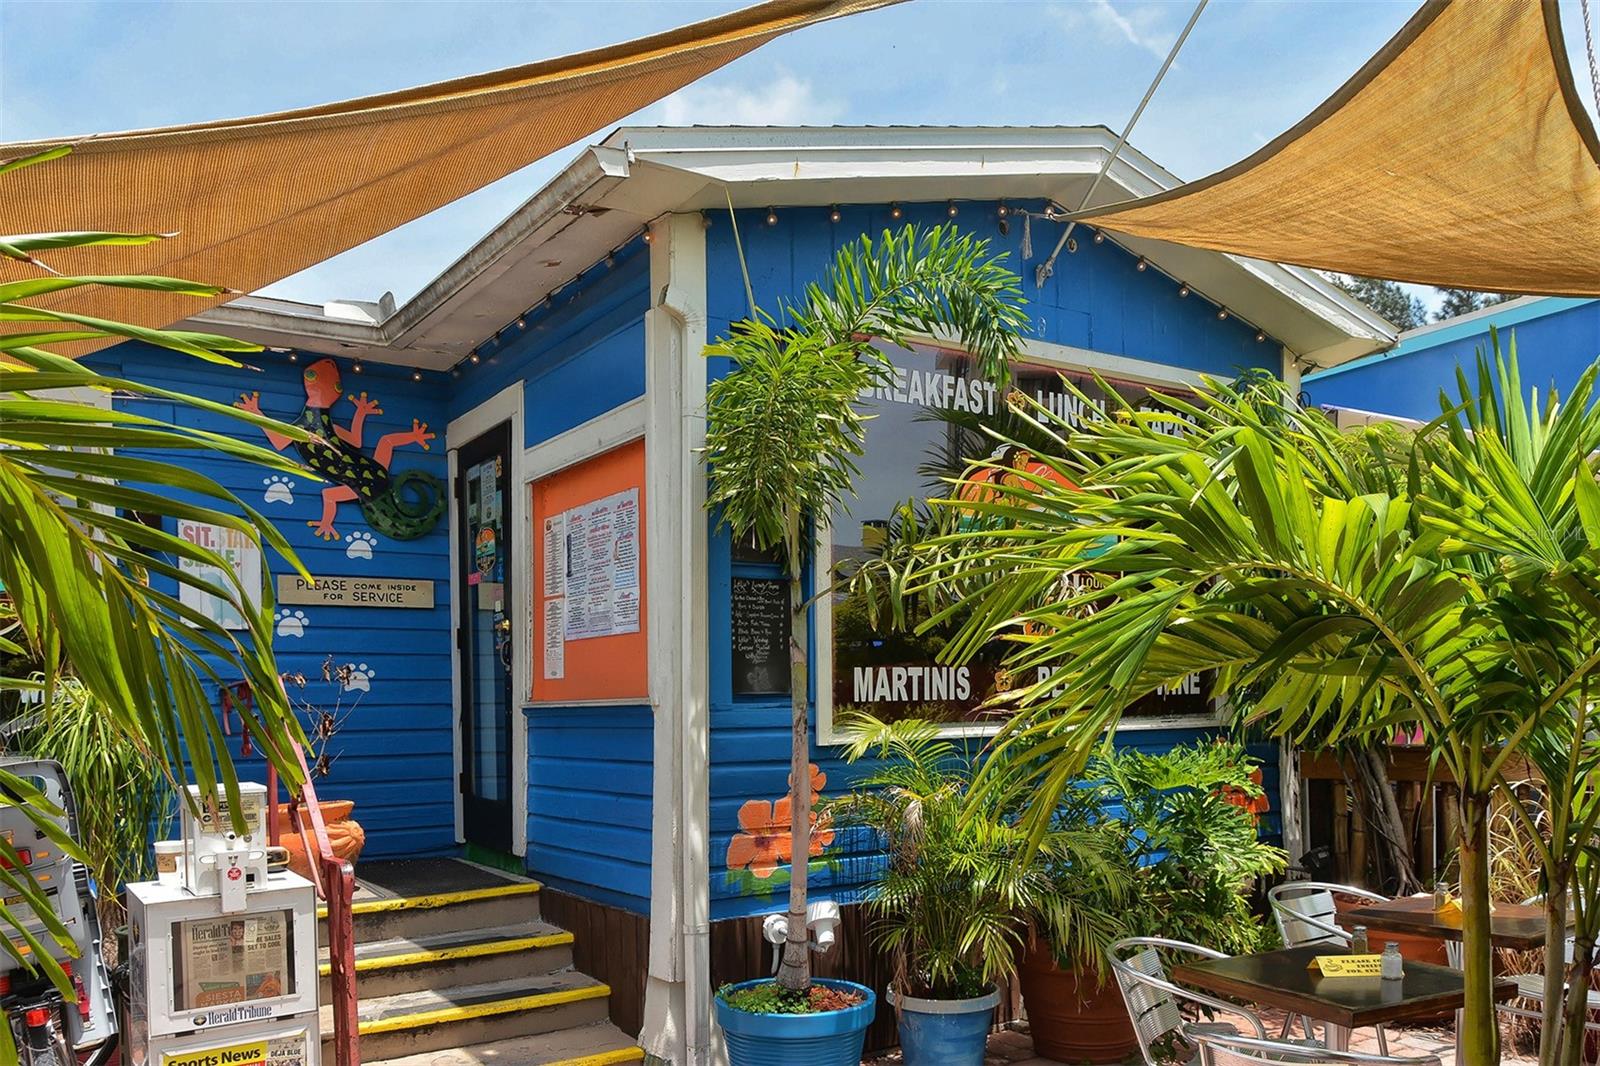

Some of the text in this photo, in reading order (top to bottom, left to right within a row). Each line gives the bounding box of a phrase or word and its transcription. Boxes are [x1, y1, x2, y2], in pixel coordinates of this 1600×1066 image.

[183, 525, 215, 547] SIT.
[296, 579, 347, 591] PLEASE
[387, 584, 417, 592] INSIDE
[352, 591, 404, 603] SERVICE
[853, 666, 971, 702] MARTINIS
[207, 990, 241, 1001] SIESTA
[221, 1048, 261, 1064] News
